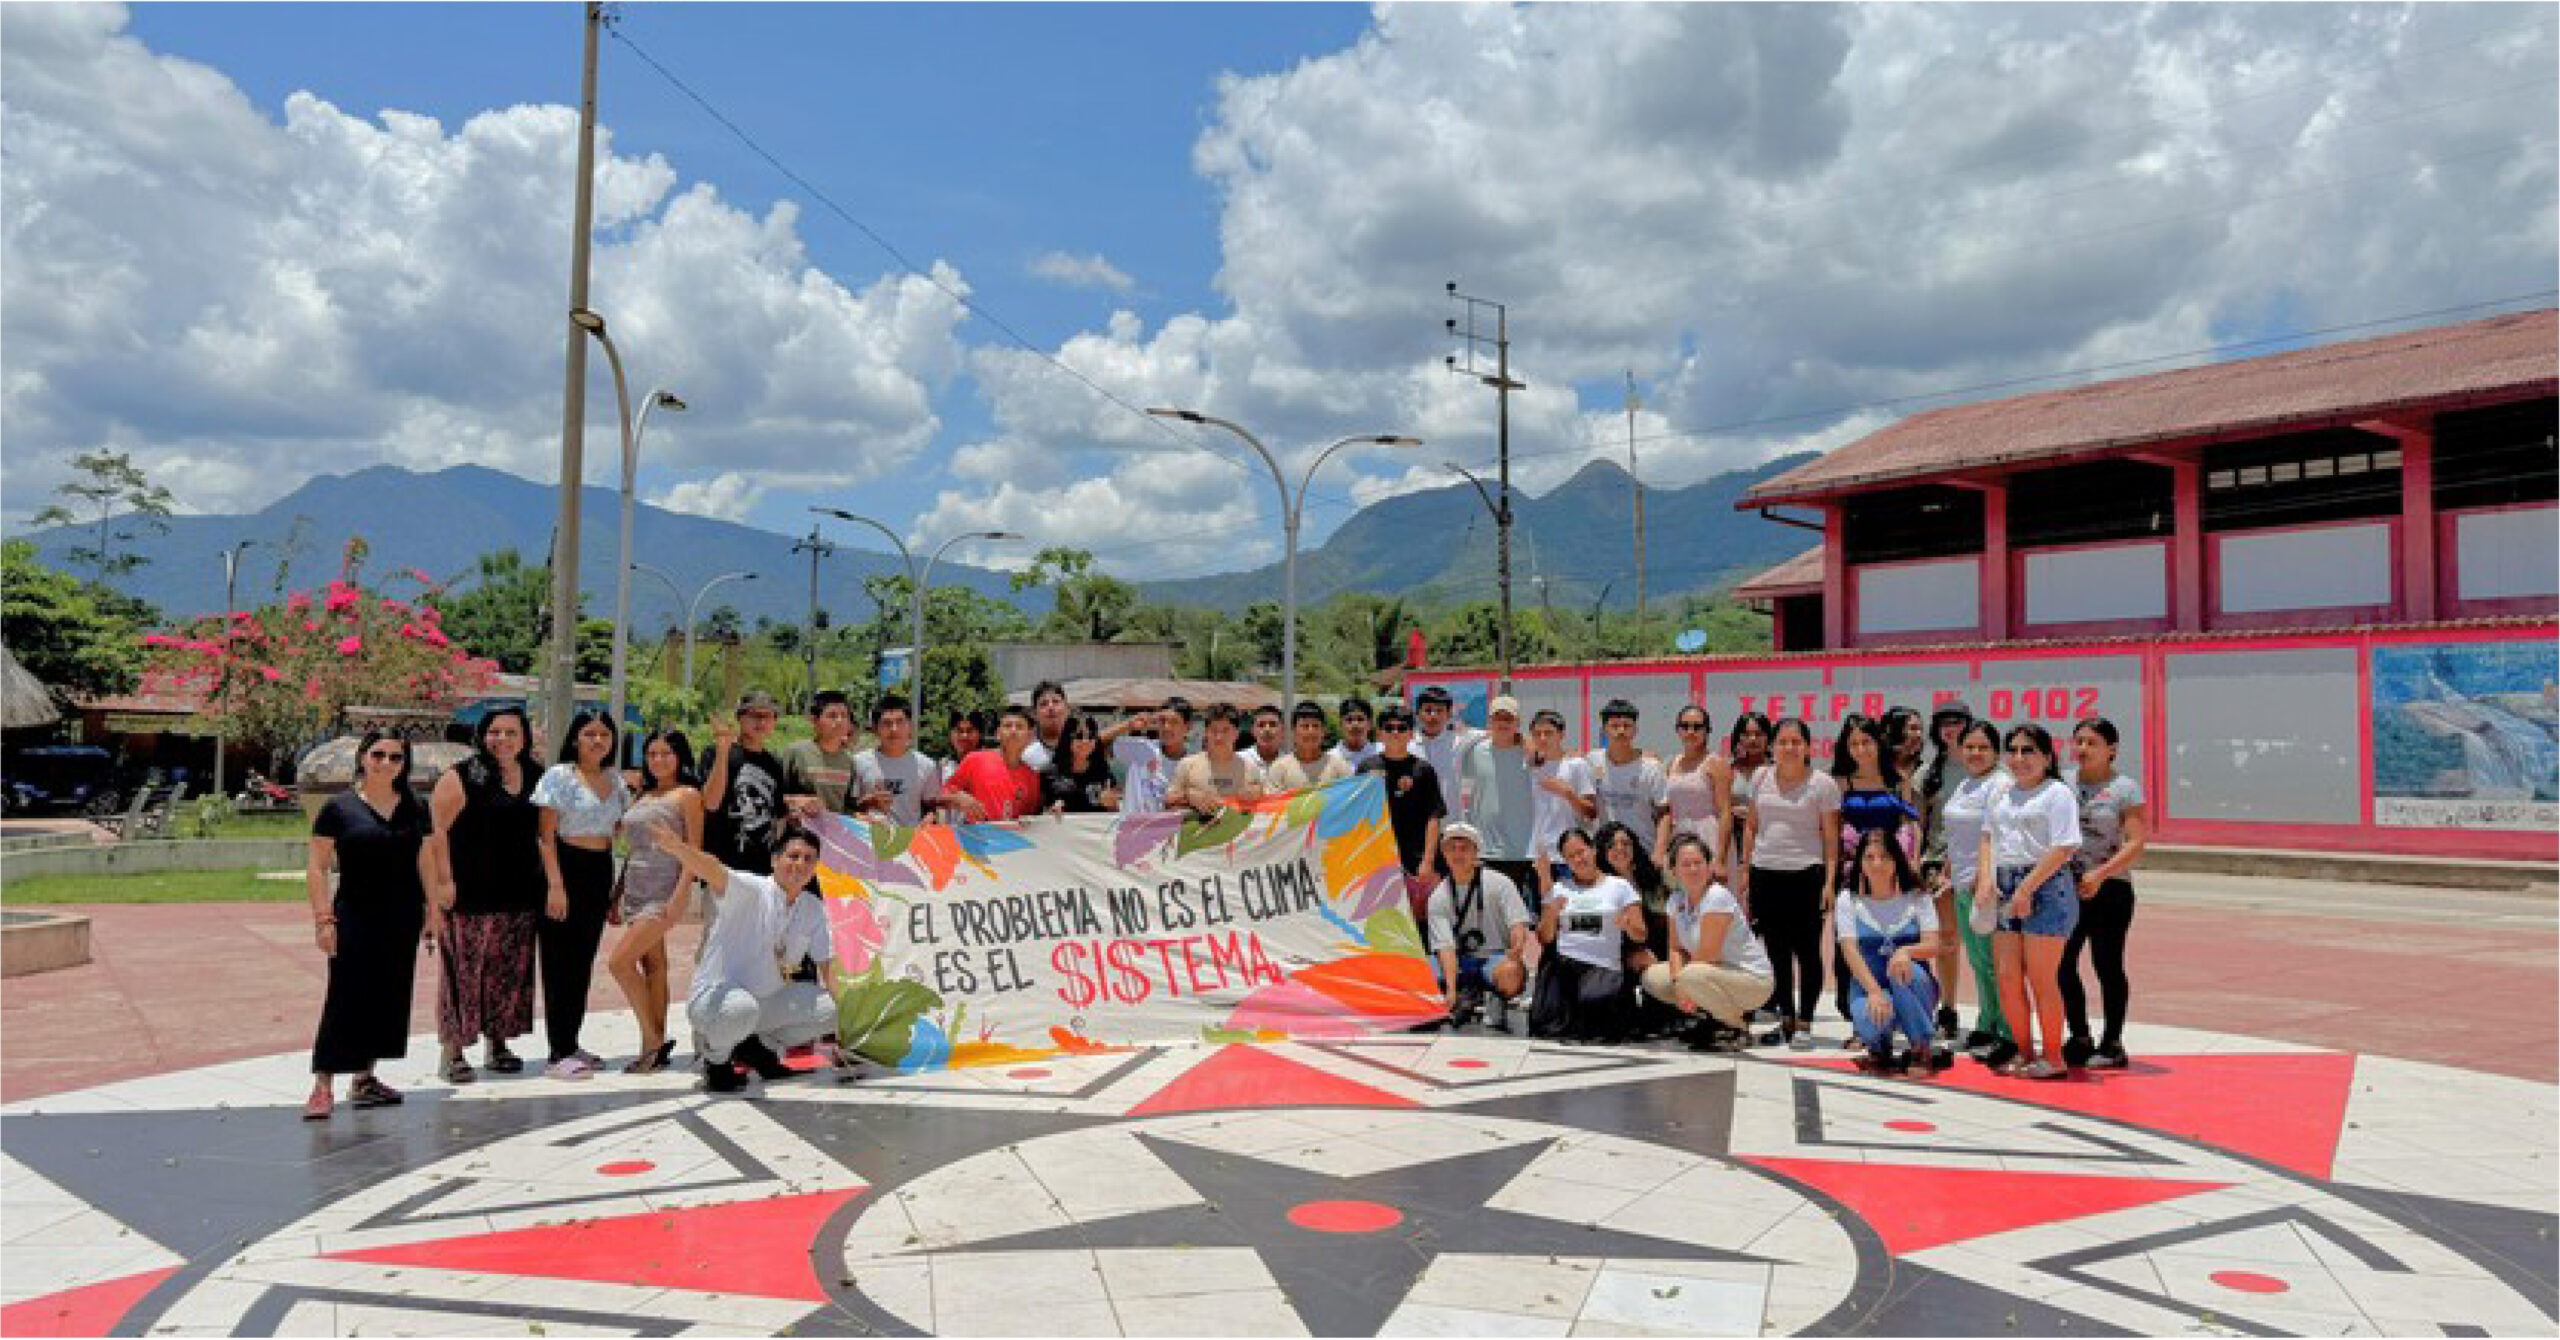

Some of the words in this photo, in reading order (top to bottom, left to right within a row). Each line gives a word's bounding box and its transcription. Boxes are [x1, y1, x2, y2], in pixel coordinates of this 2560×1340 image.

[1988, 687, 2099, 722] 0102
[910, 902, 940, 944] EL
[948, 888, 1102, 946] PROBLEMA
[1107, 887, 1148, 936] NO
[1159, 878, 1197, 931] ES
[1202, 873, 1233, 924] EL
[1239, 857, 1322, 921] CLIMA
[935, 950, 977, 995] ES
[986, 948, 1035, 992] EL
